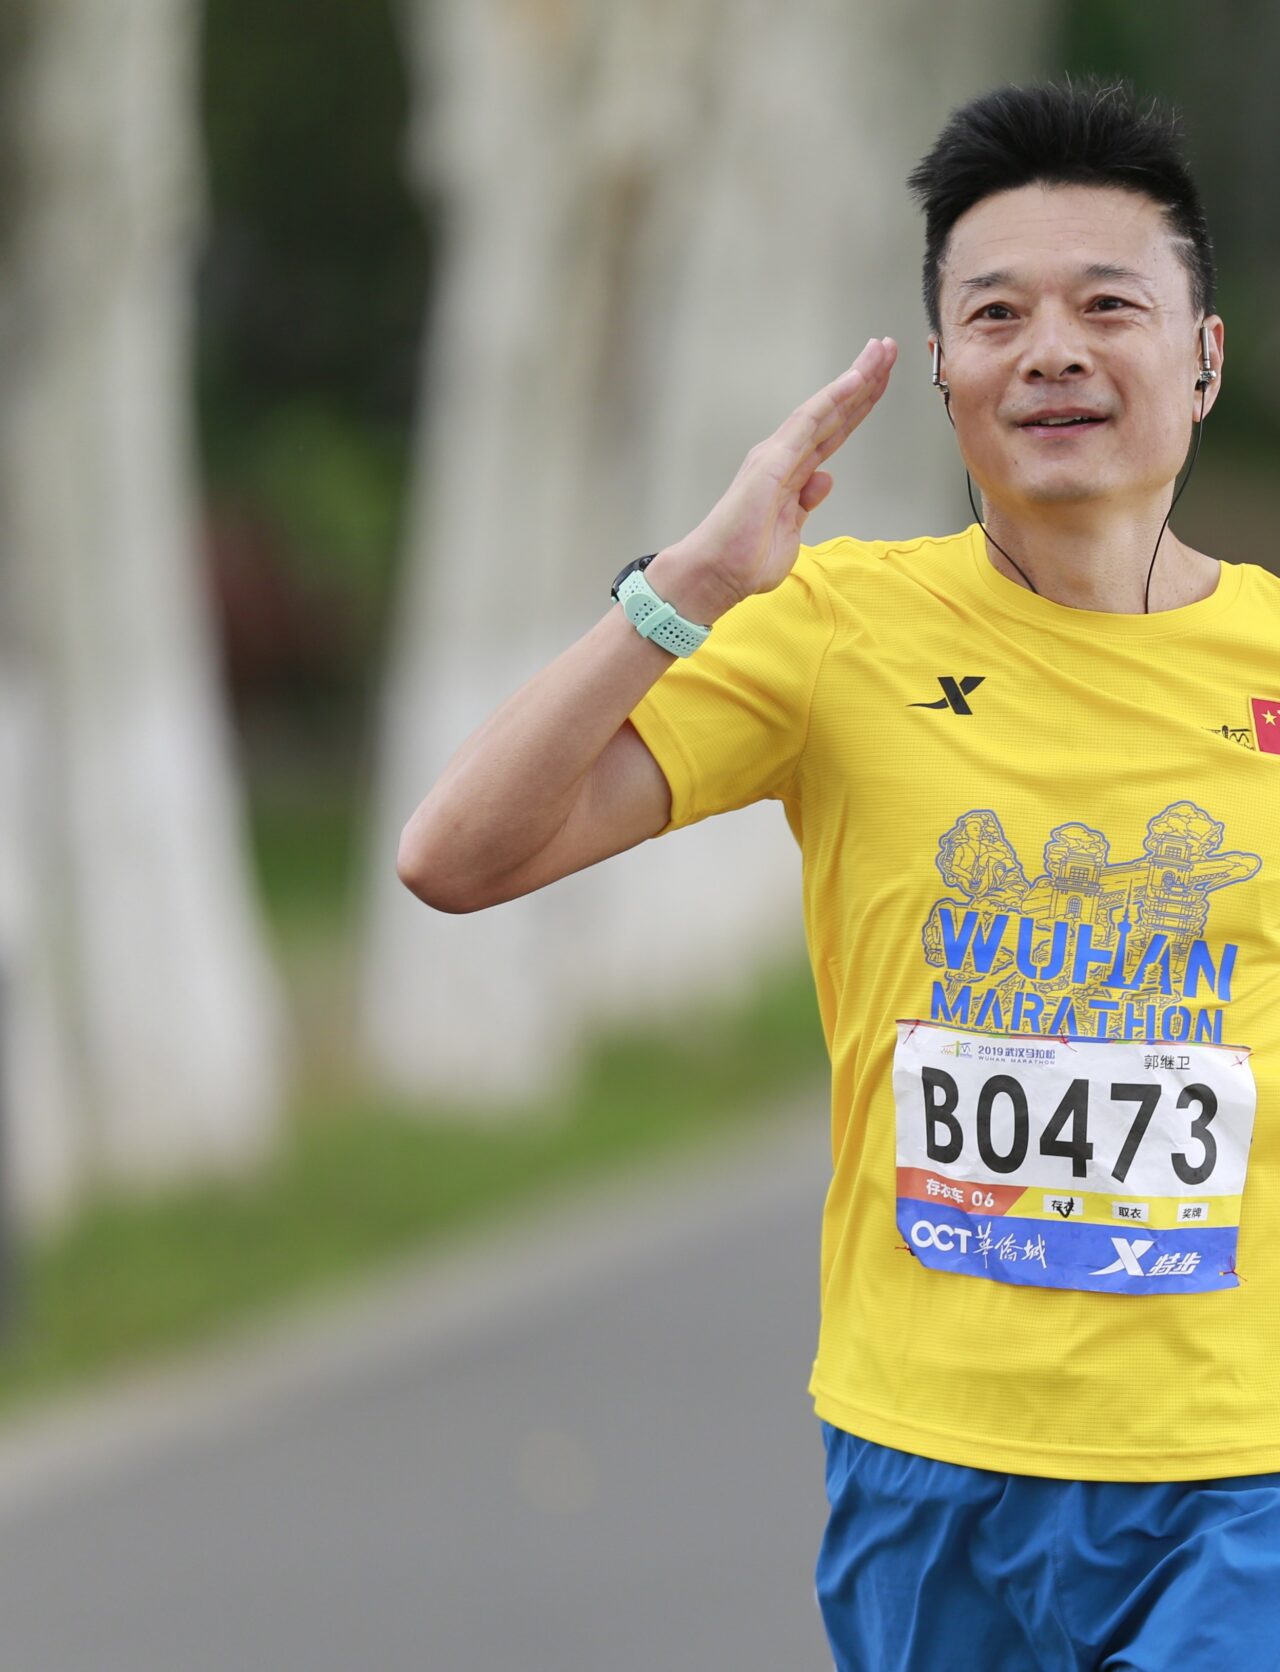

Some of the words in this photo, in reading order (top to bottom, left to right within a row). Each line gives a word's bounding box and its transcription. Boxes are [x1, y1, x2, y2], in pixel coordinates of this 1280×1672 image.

[938, 908, 1238, 1002] WUHAN
[930, 981, 1223, 1044] MARATHON
[1144, 1054, 1191, 1070] 郭继卫
[922, 1066, 1219, 1186] B0473
[926, 1178, 964, 1204] 存衣车
[971, 1191, 995, 1208] 06
[1118, 1206, 1142, 1219] 取衣
[1182, 1207, 1202, 1219] 奖牌
[911, 1220, 972, 1254] OCT
[1146, 1252, 1201, 1276] 特步
